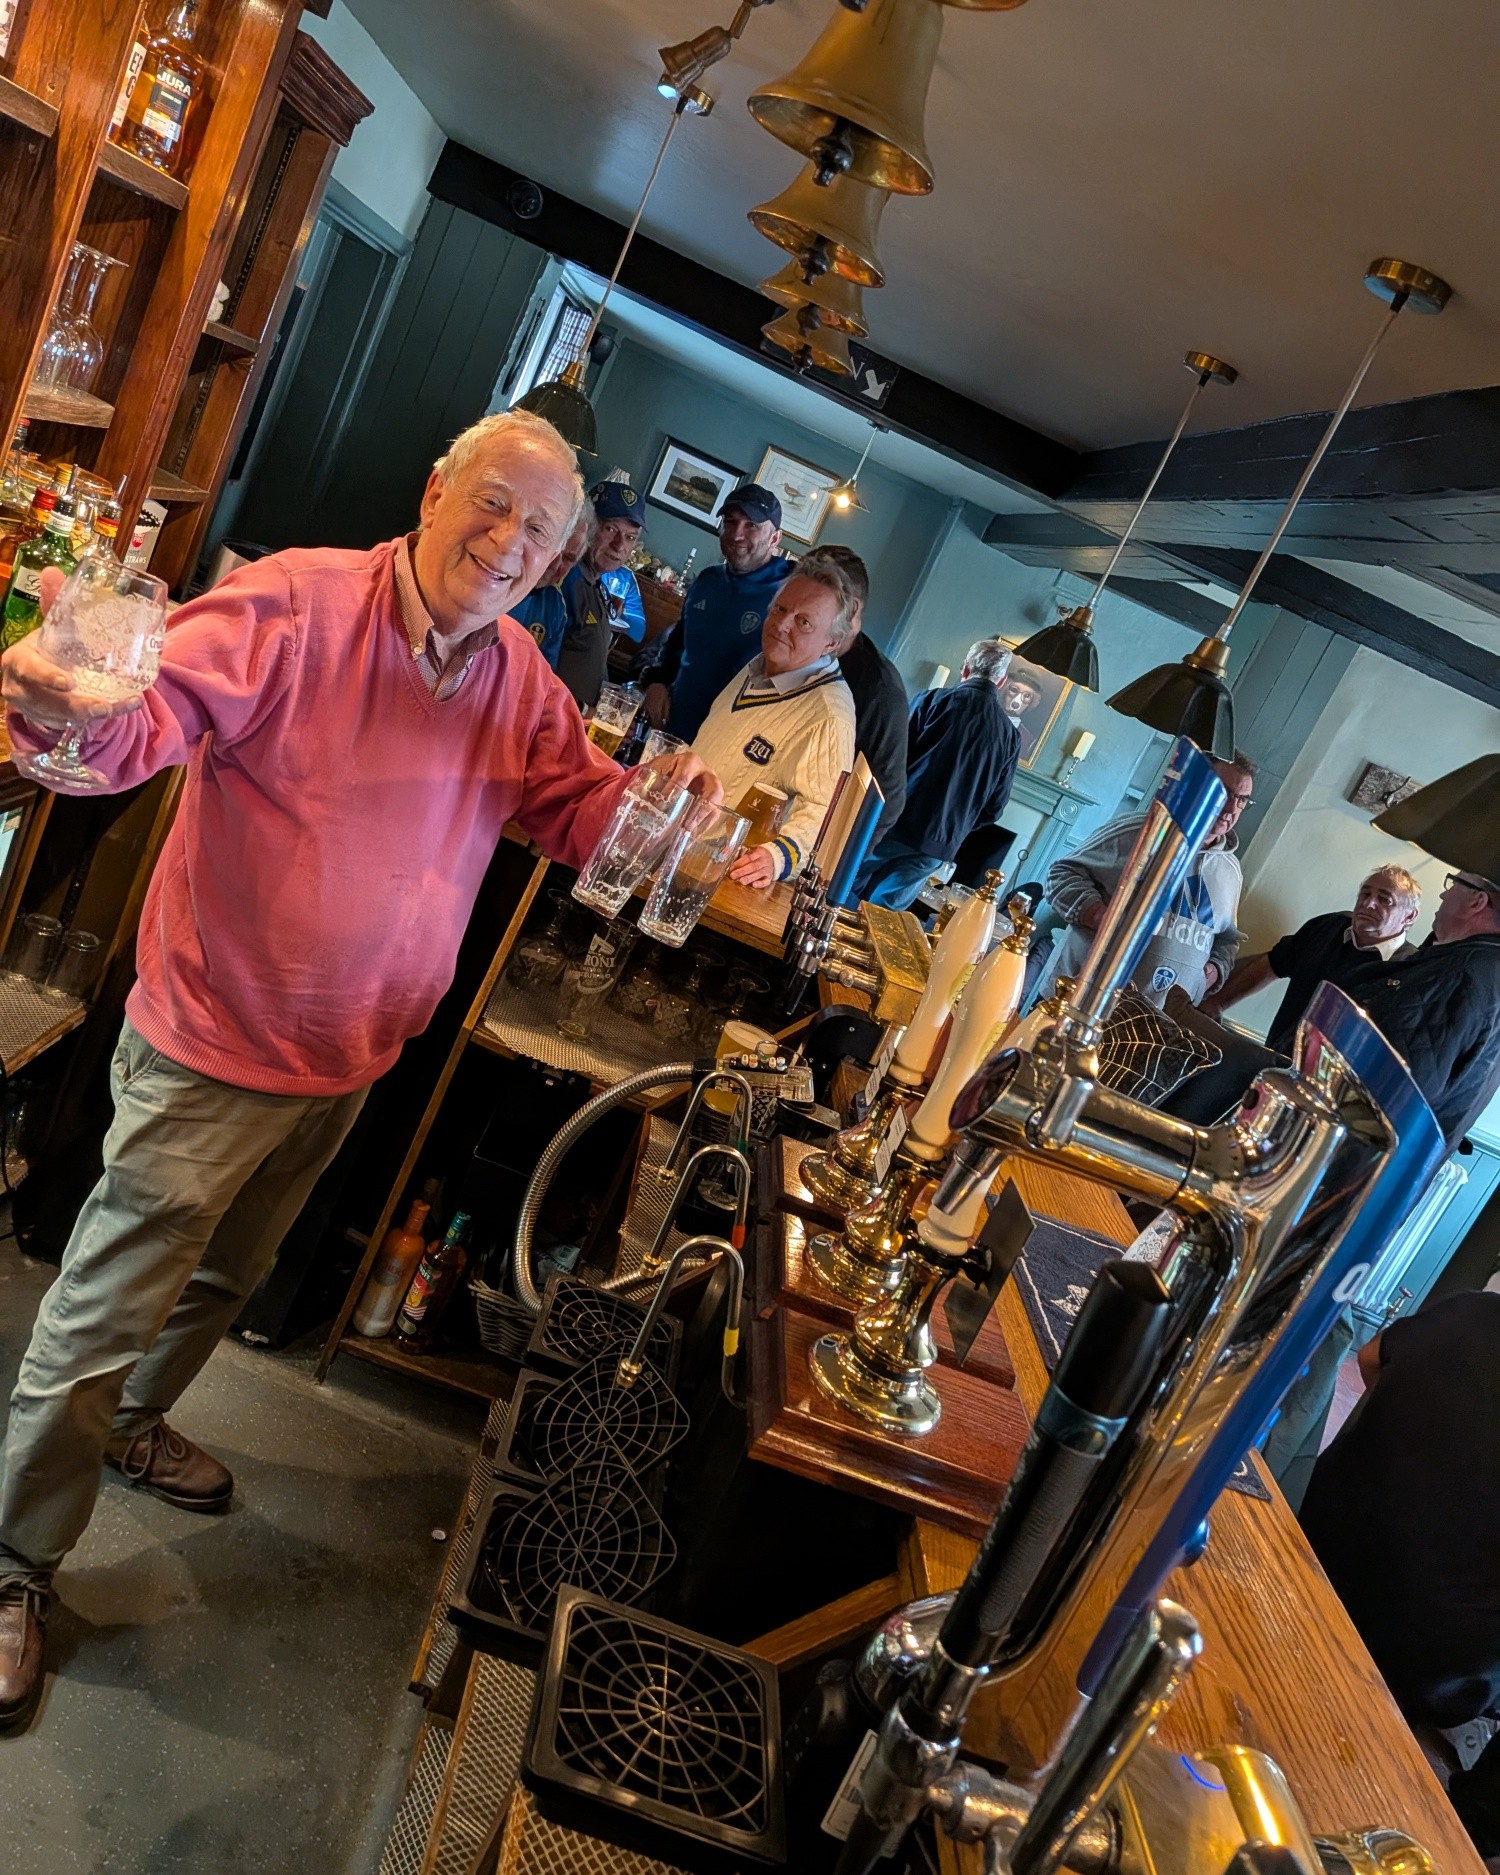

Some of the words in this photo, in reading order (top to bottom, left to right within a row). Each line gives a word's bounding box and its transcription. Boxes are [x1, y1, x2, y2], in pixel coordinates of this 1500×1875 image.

[156, 71, 191, 97] JURA
[124, 555, 147, 564] STRAWS
[583, 954, 616, 968] RONI
